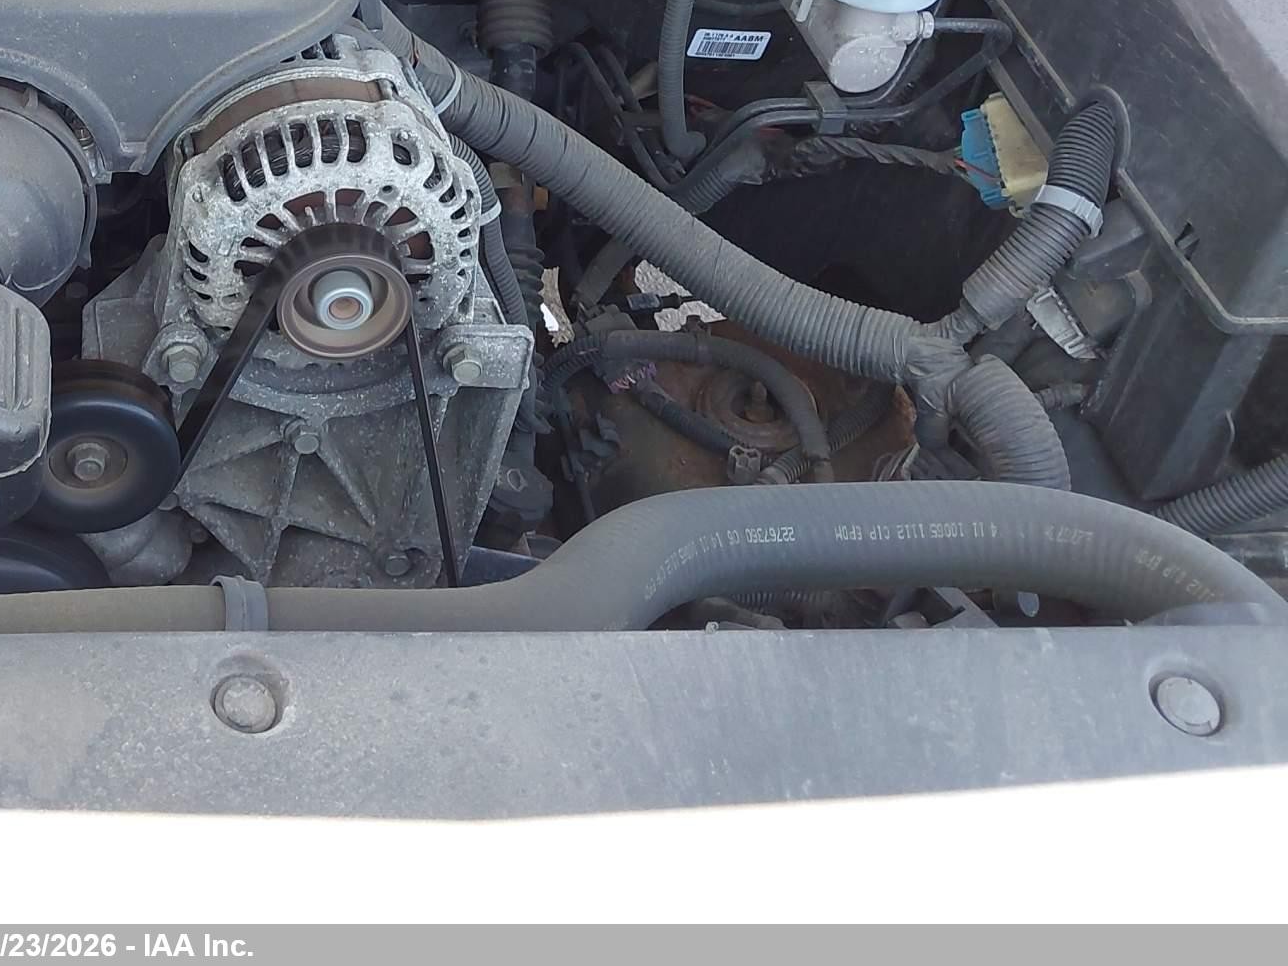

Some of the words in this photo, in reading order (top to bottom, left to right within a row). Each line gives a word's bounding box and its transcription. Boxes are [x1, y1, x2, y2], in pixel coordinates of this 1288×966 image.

[744, 526, 796, 542] 22767360
[834, 525, 864, 541] EPDM
[869, 524, 890, 541] CIP
[897, 523, 925, 540] 1112
[930, 523, 965, 538] 10065
